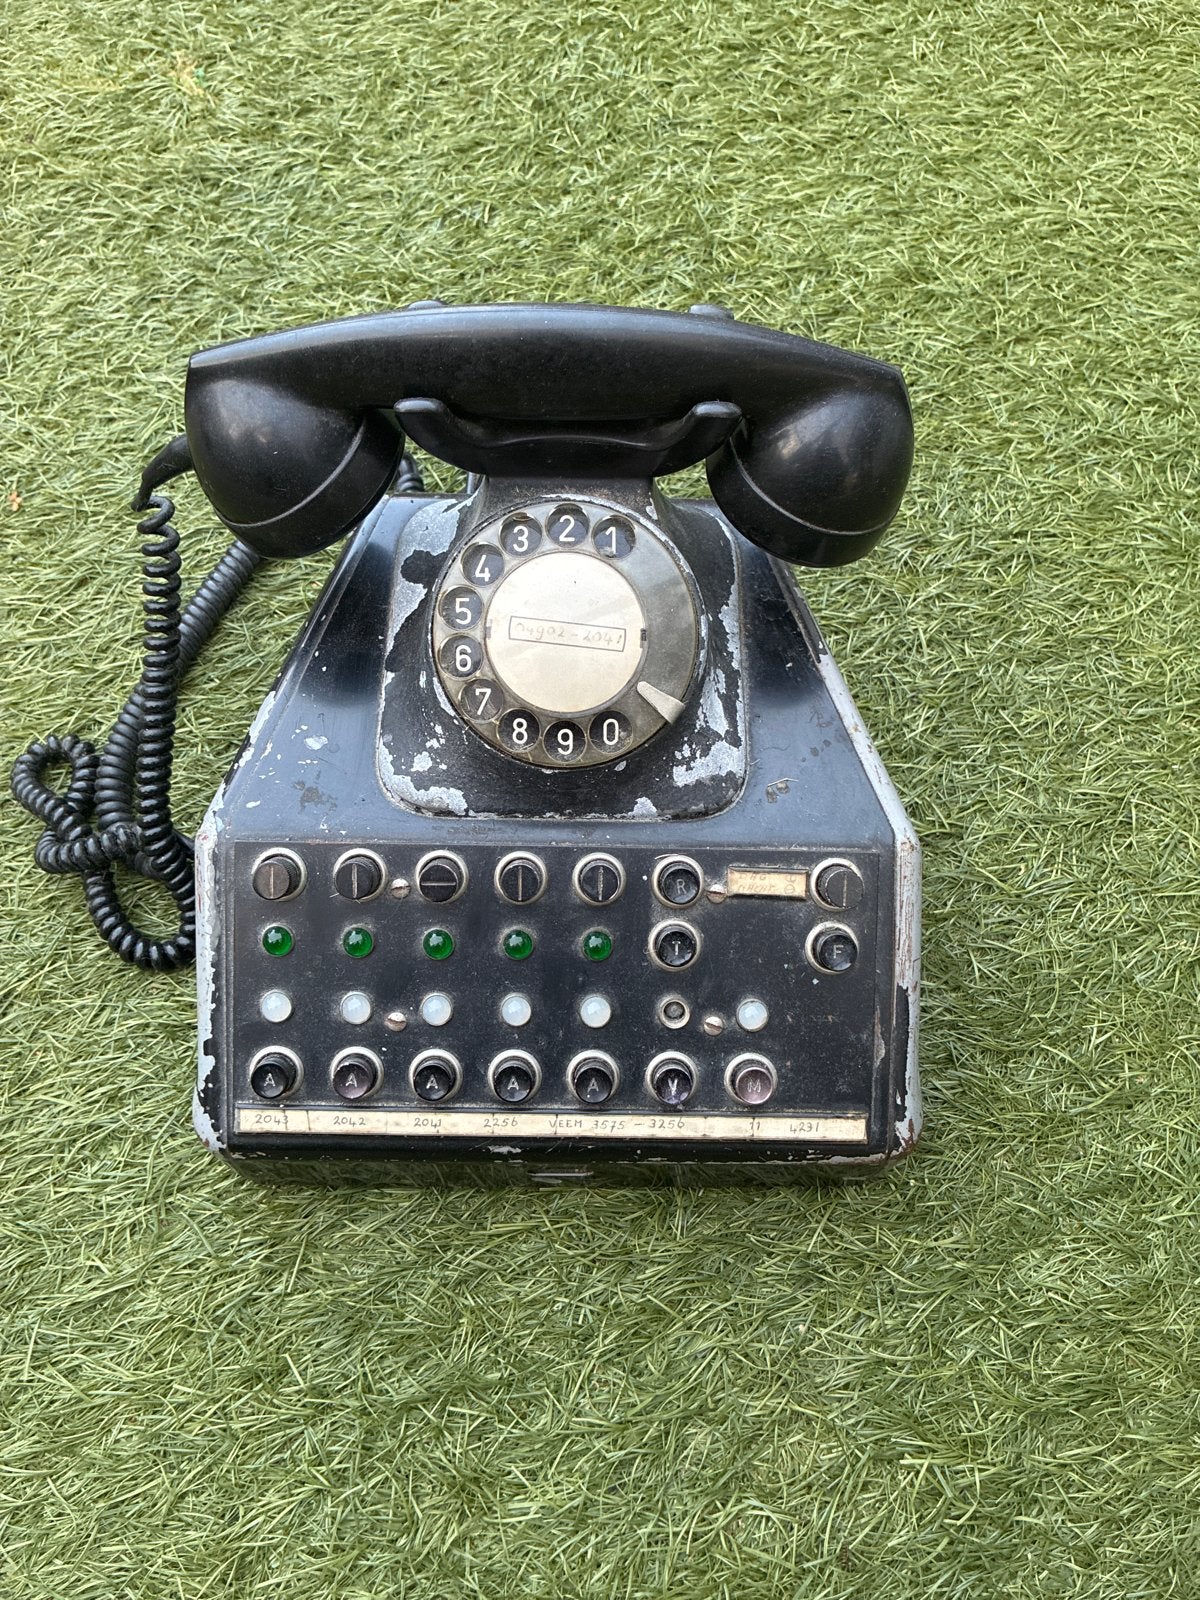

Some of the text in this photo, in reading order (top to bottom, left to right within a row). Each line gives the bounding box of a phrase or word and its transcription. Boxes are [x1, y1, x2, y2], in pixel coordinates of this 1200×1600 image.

[512, 526, 529, 552] 3
[558, 515, 575, 542] 2
[604, 526, 616, 555] 1
[474, 554, 491, 582] 4
[455, 598, 472, 625] 5
[455, 645, 472, 672] 6
[475, 688, 492, 715] 7
[511, 718, 528, 744] 8
[557, 729, 574, 755] 9
[602, 718, 619, 745] 0
[676, 878, 686, 895] R
[671, 940, 682, 956] T
[832, 944, 844, 959] F
[263, 1073, 276, 1087] A
[345, 1072, 358, 1087] A
[425, 1074, 438, 1090] A
[506, 1075, 520, 1091] A
[587, 1077, 599, 1092] A
[747, 1079, 761, 1093] M
[255, 1113, 289, 1126] 2043
[333, 1115, 367, 1127] 2042
[413, 1117, 442, 1129] 2041
[483, 1116, 518, 1128] 2256
[548, 1118, 583, 1129] VEEM
[591, 1119, 626, 1133] 3575
[648, 1116, 685, 1129] 3256
